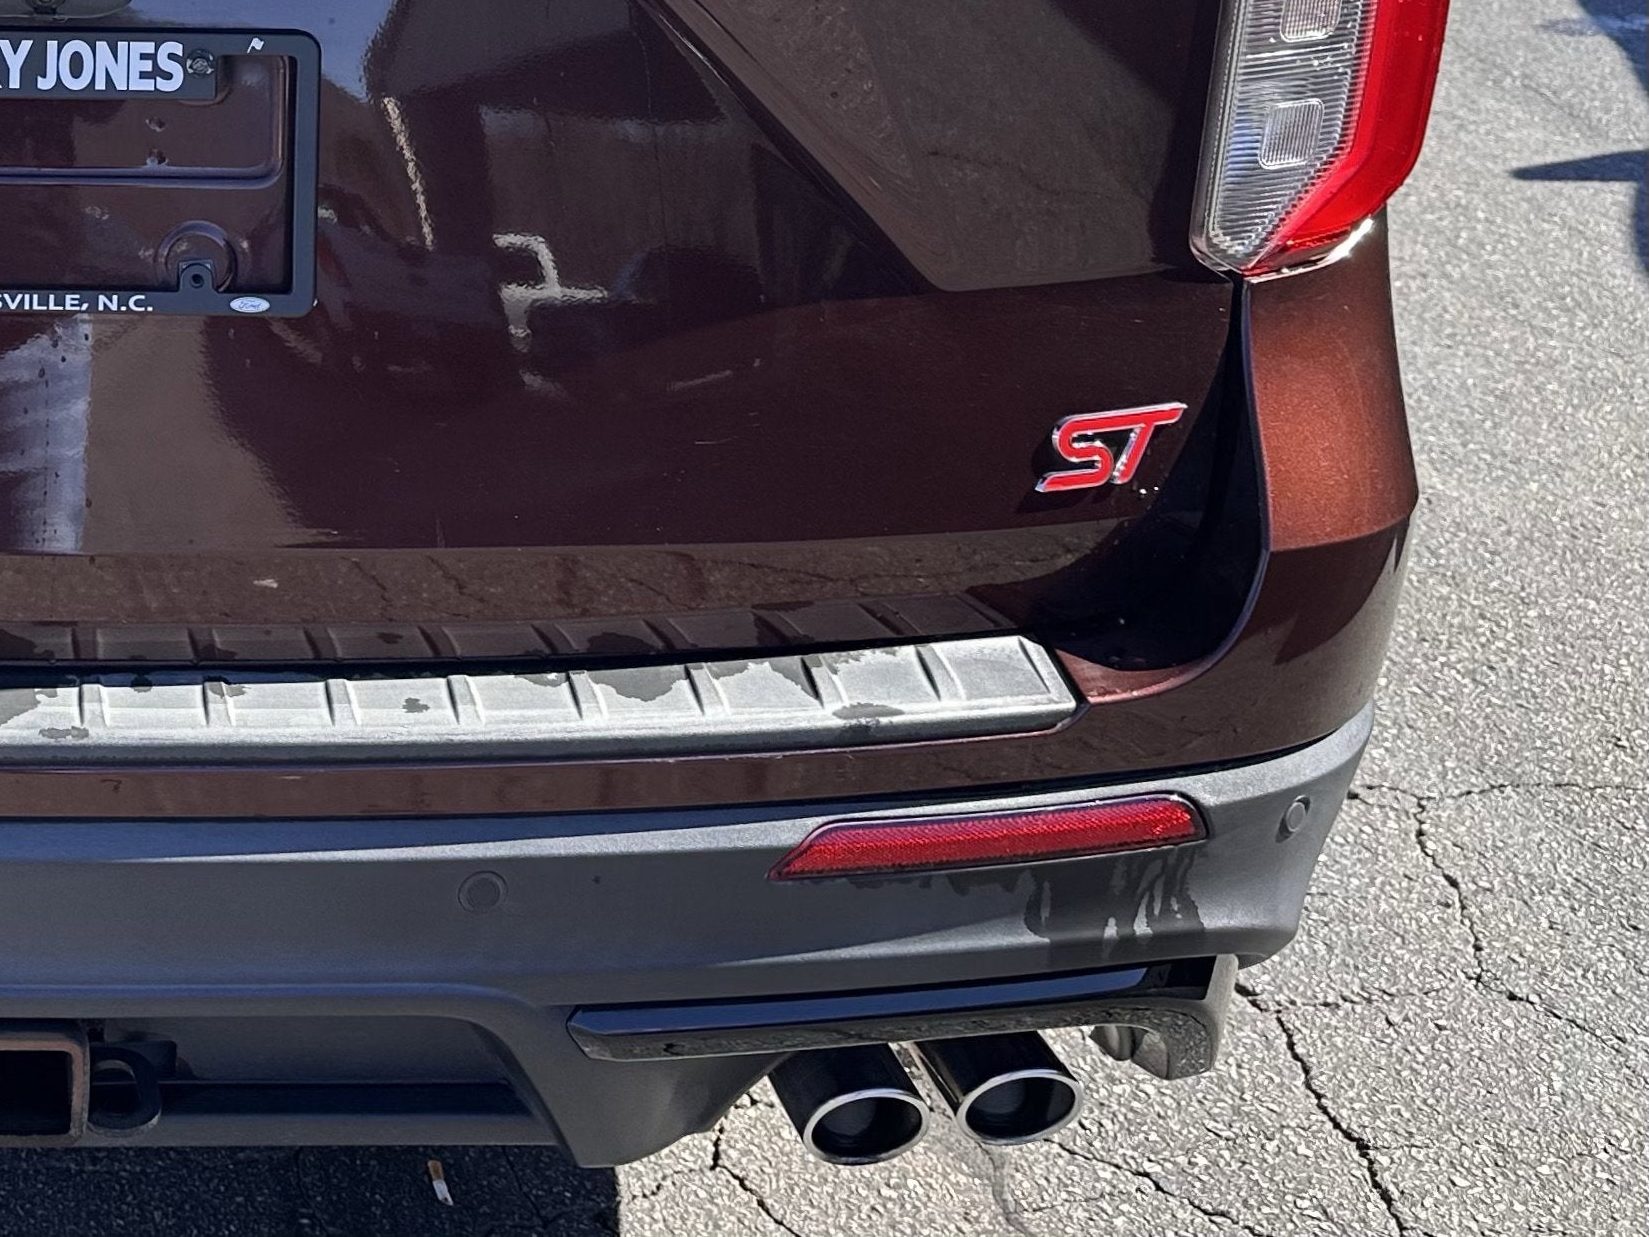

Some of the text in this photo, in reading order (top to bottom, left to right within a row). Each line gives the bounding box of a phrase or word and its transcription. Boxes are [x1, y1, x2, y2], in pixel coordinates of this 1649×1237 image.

[37, 40, 184, 92] JONES
[97, 294, 154, 312] N.C.
[1034, 401, 1188, 493] ST
